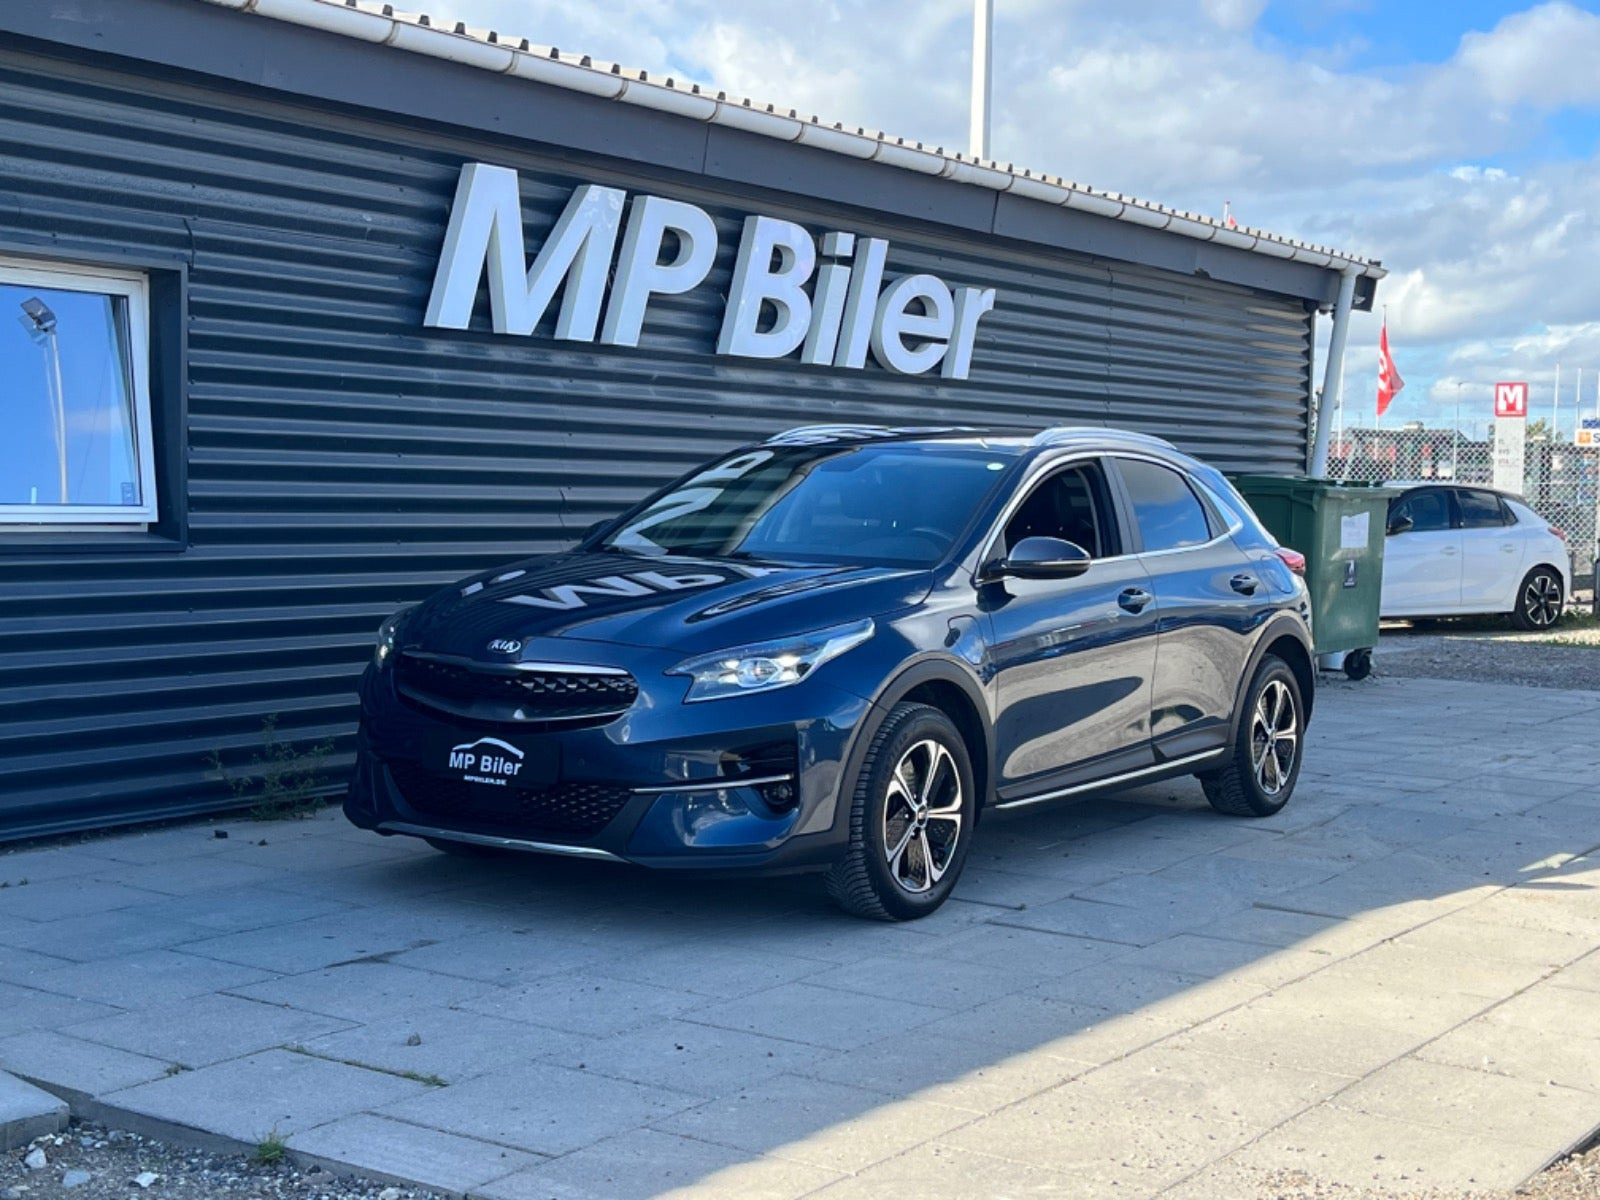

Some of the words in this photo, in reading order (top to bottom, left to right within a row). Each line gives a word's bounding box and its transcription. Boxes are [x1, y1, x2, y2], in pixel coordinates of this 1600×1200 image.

[424, 162, 718, 347] MP
[716, 215, 995, 380] Biler
[1498, 385, 1523, 411] M
[490, 639, 517, 651] KIA
[449, 752, 475, 769] MP
[480, 755, 522, 775] Biler
